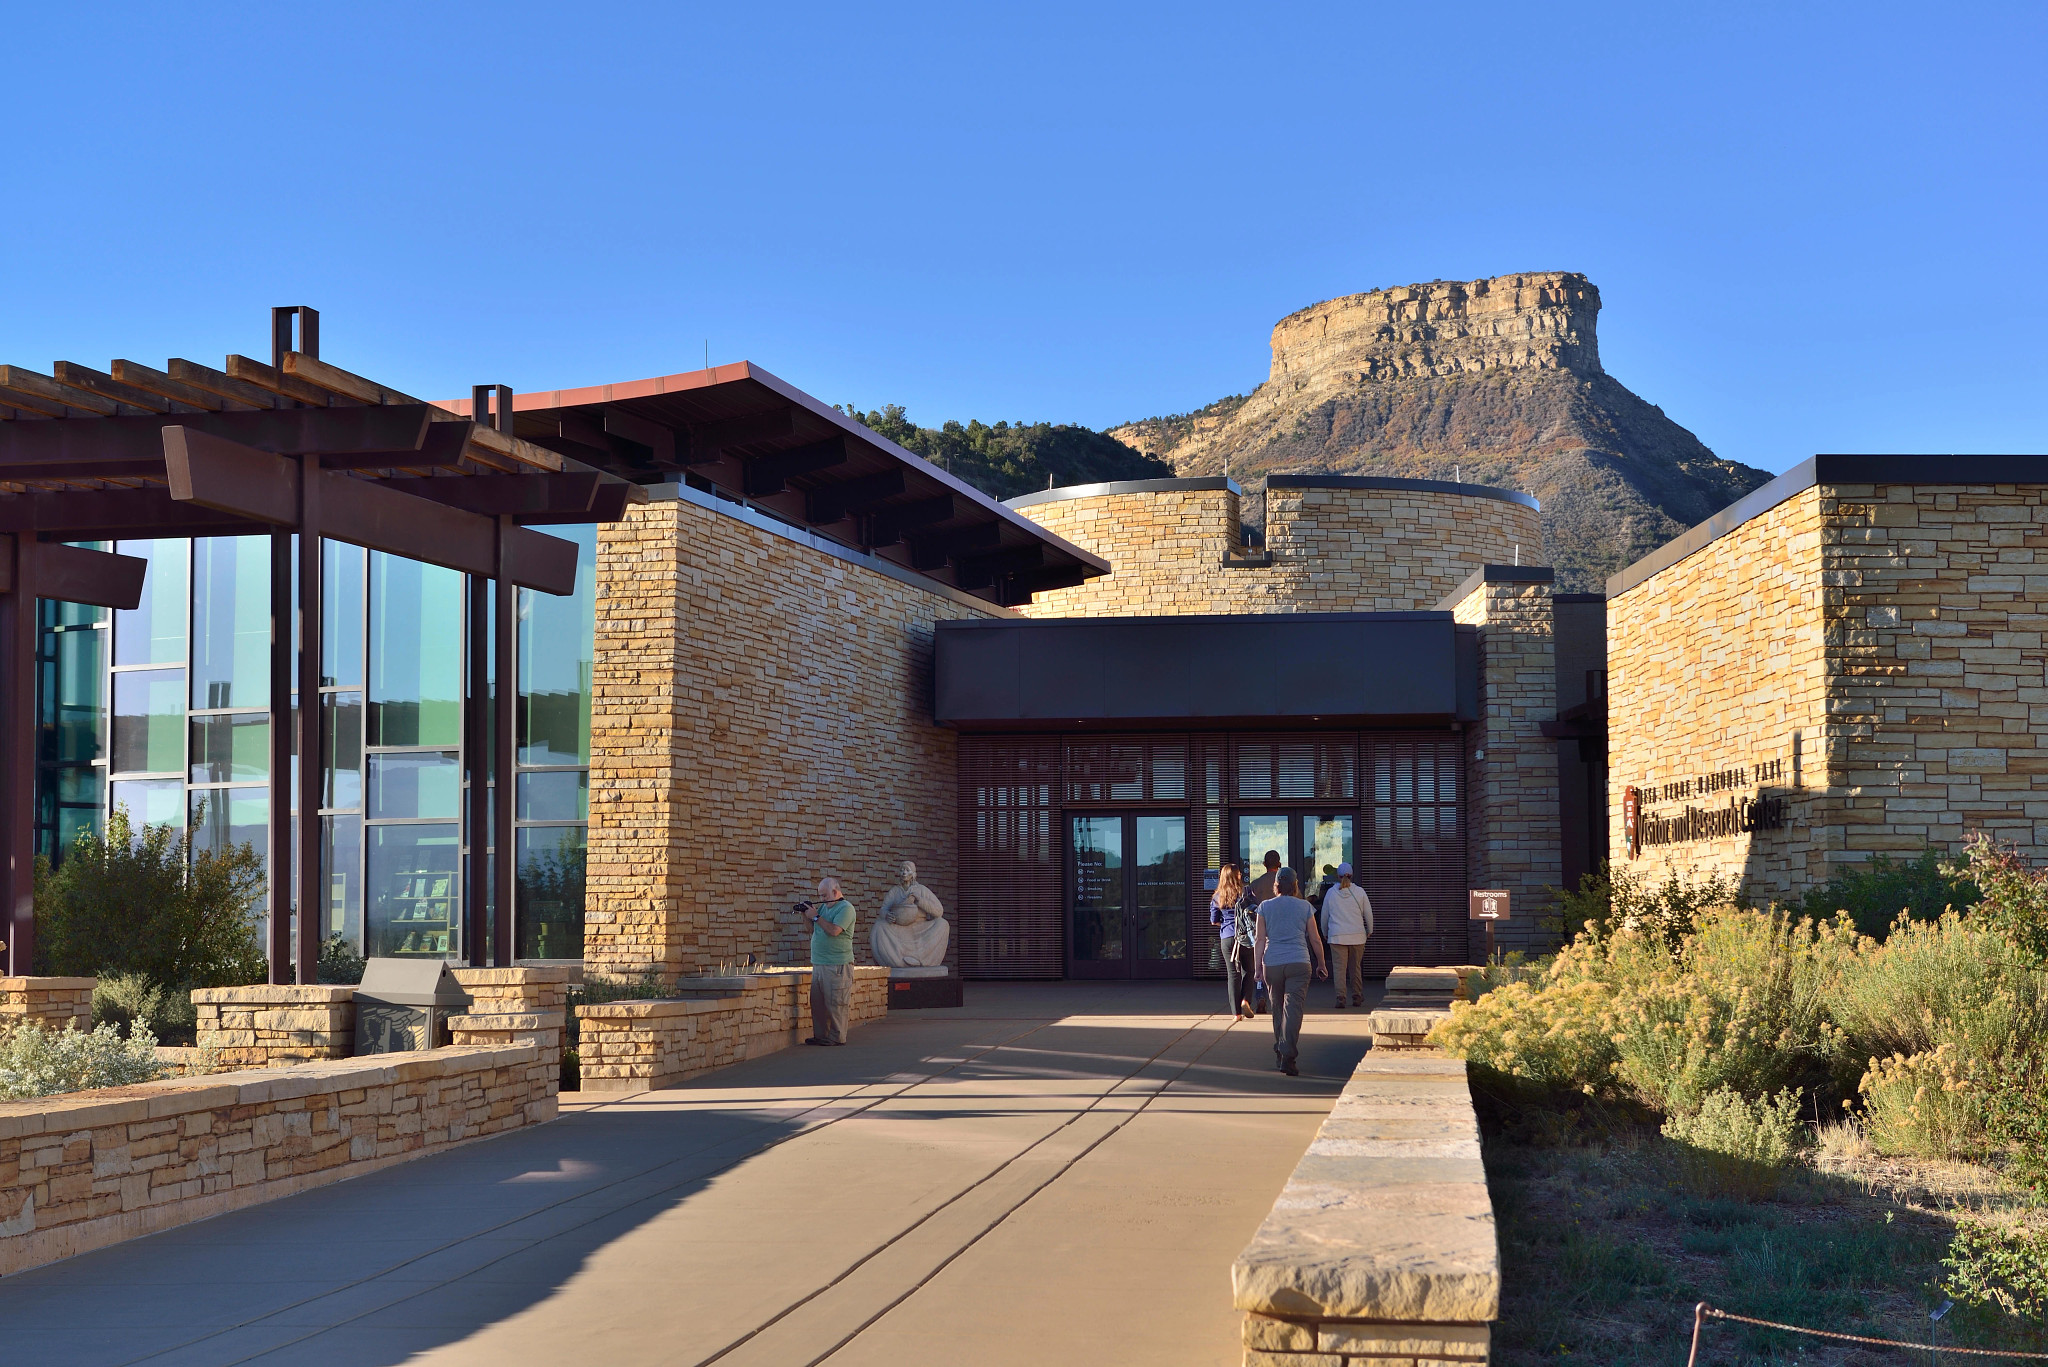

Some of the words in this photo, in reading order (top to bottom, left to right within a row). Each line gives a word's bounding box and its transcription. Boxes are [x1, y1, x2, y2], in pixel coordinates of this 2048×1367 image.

[1664, 780, 1690, 801] VERDE
[1698, 767, 1745, 793] NATIONAL
[1755, 759, 1781, 782] PARK
[1637, 811, 1670, 846] Visitor
[1672, 805, 1690, 842] and
[1690, 796, 1739, 841] Research
[1740, 794, 1782, 833] Center
